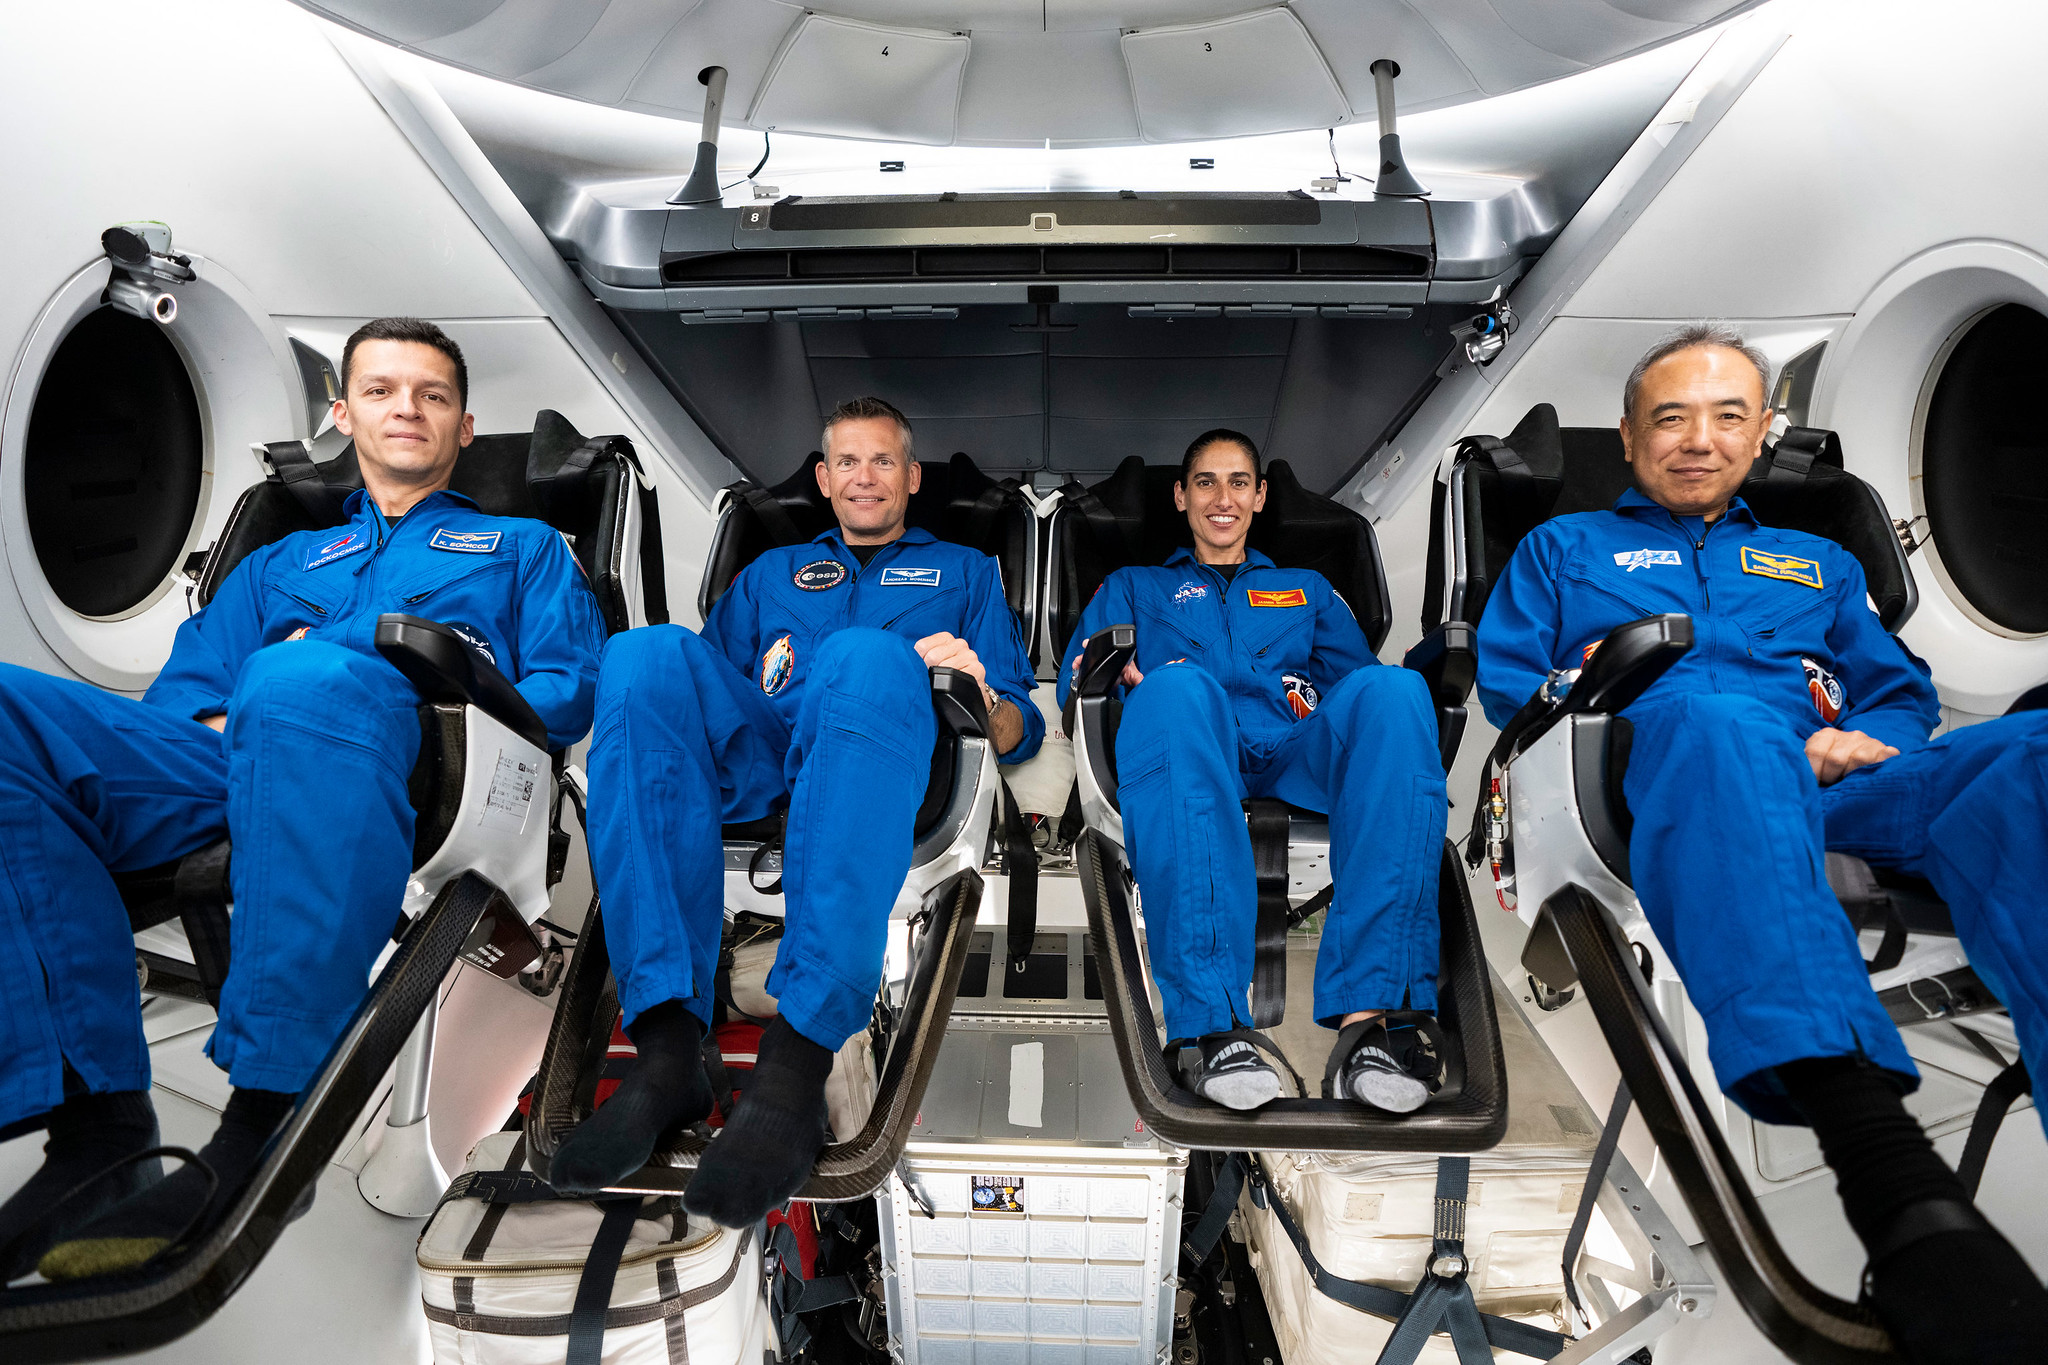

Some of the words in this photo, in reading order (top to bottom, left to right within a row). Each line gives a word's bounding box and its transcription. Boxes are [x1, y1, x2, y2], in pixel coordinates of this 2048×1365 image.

[881, 46, 889, 57] 4
[1204, 42, 1213, 52] 3
[750, 212, 760, 223] 8
[308, 542, 365, 569] РОСКОСМОС
[1625, 551, 1677, 566] JAXA
[1174, 587, 1207, 600] NASA
